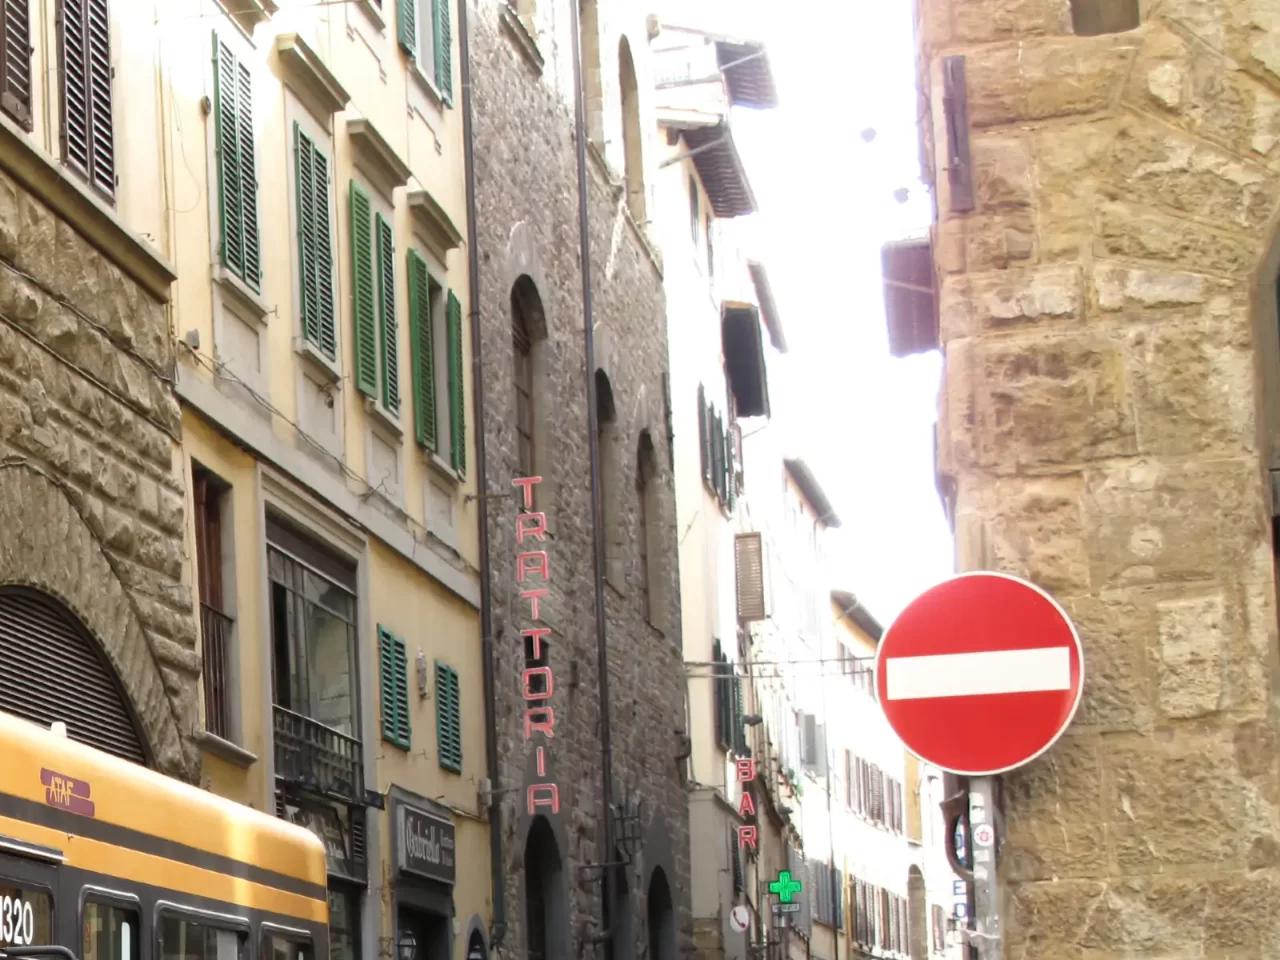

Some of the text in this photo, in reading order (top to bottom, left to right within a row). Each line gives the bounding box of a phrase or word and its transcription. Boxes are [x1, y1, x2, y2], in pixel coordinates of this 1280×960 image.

[512, 475, 560, 815] TRATTORIA
[49, 775, 75, 807] ATAF
[736, 759, 758, 848] BAR
